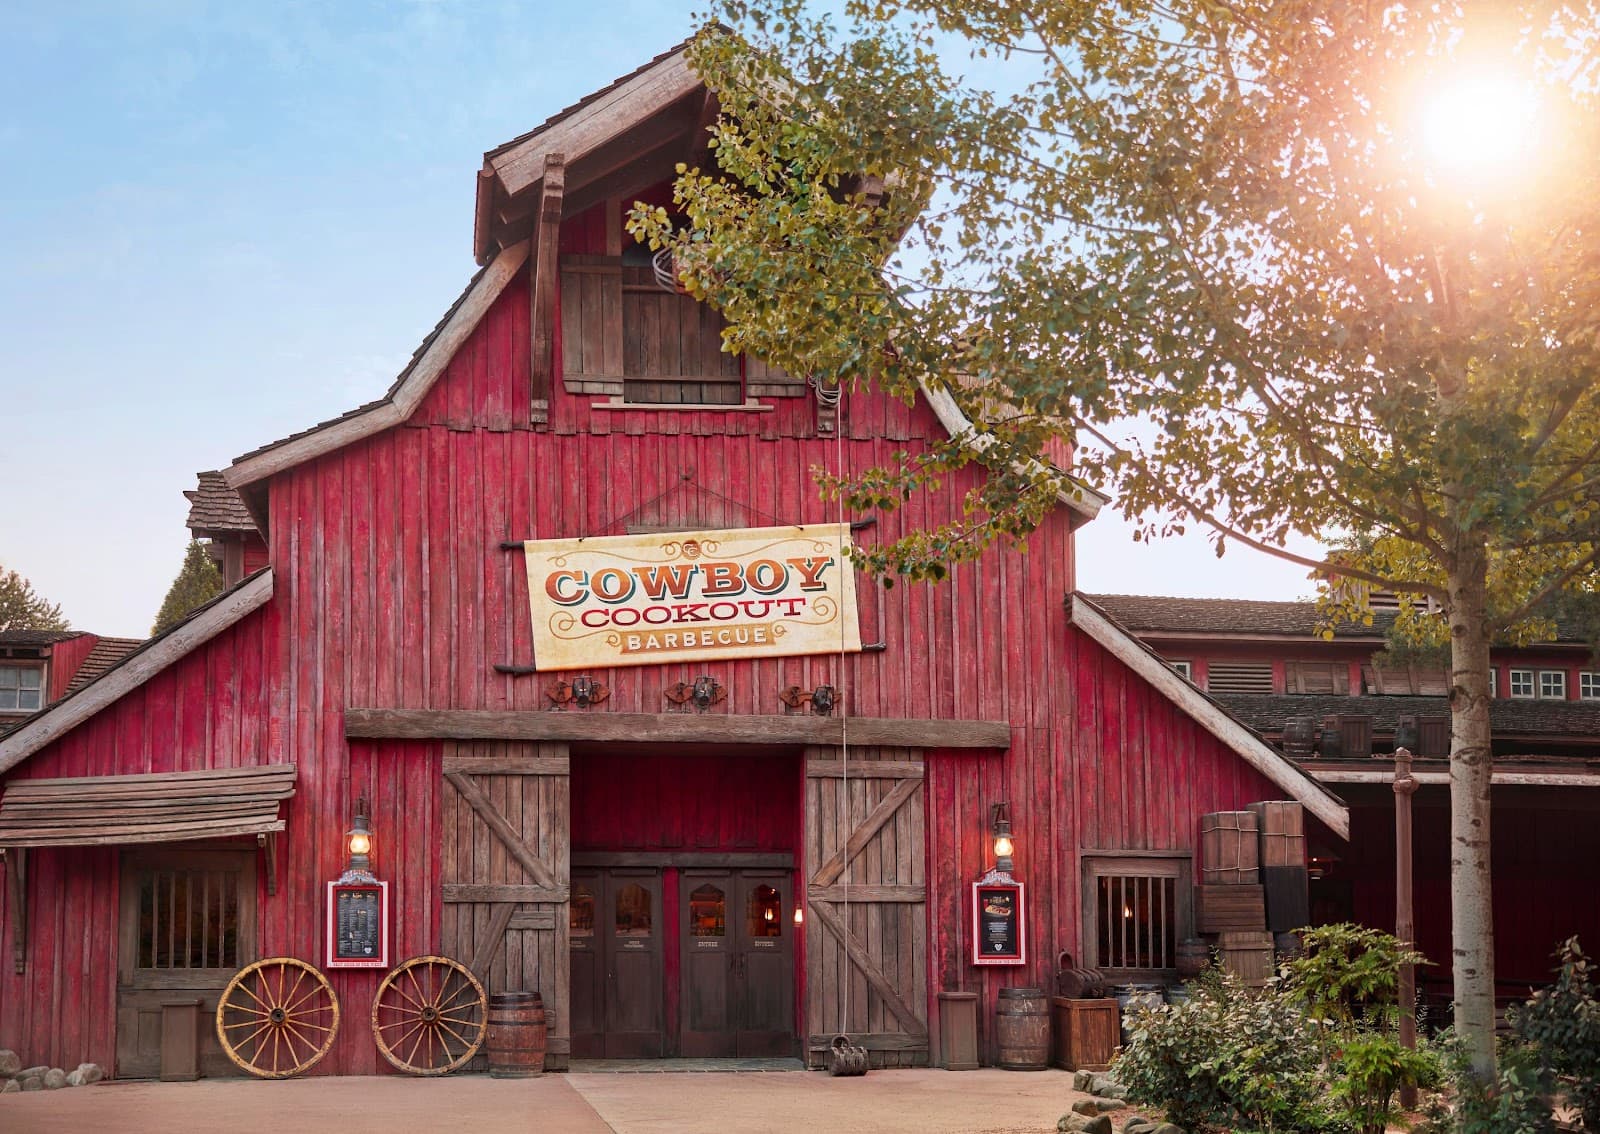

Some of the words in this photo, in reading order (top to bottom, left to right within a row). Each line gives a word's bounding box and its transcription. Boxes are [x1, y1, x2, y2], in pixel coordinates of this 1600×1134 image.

[544, 556, 834, 606] COWBOY
[580, 597, 806, 628] COOKOUT
[627, 628, 768, 651] BARBECUE
